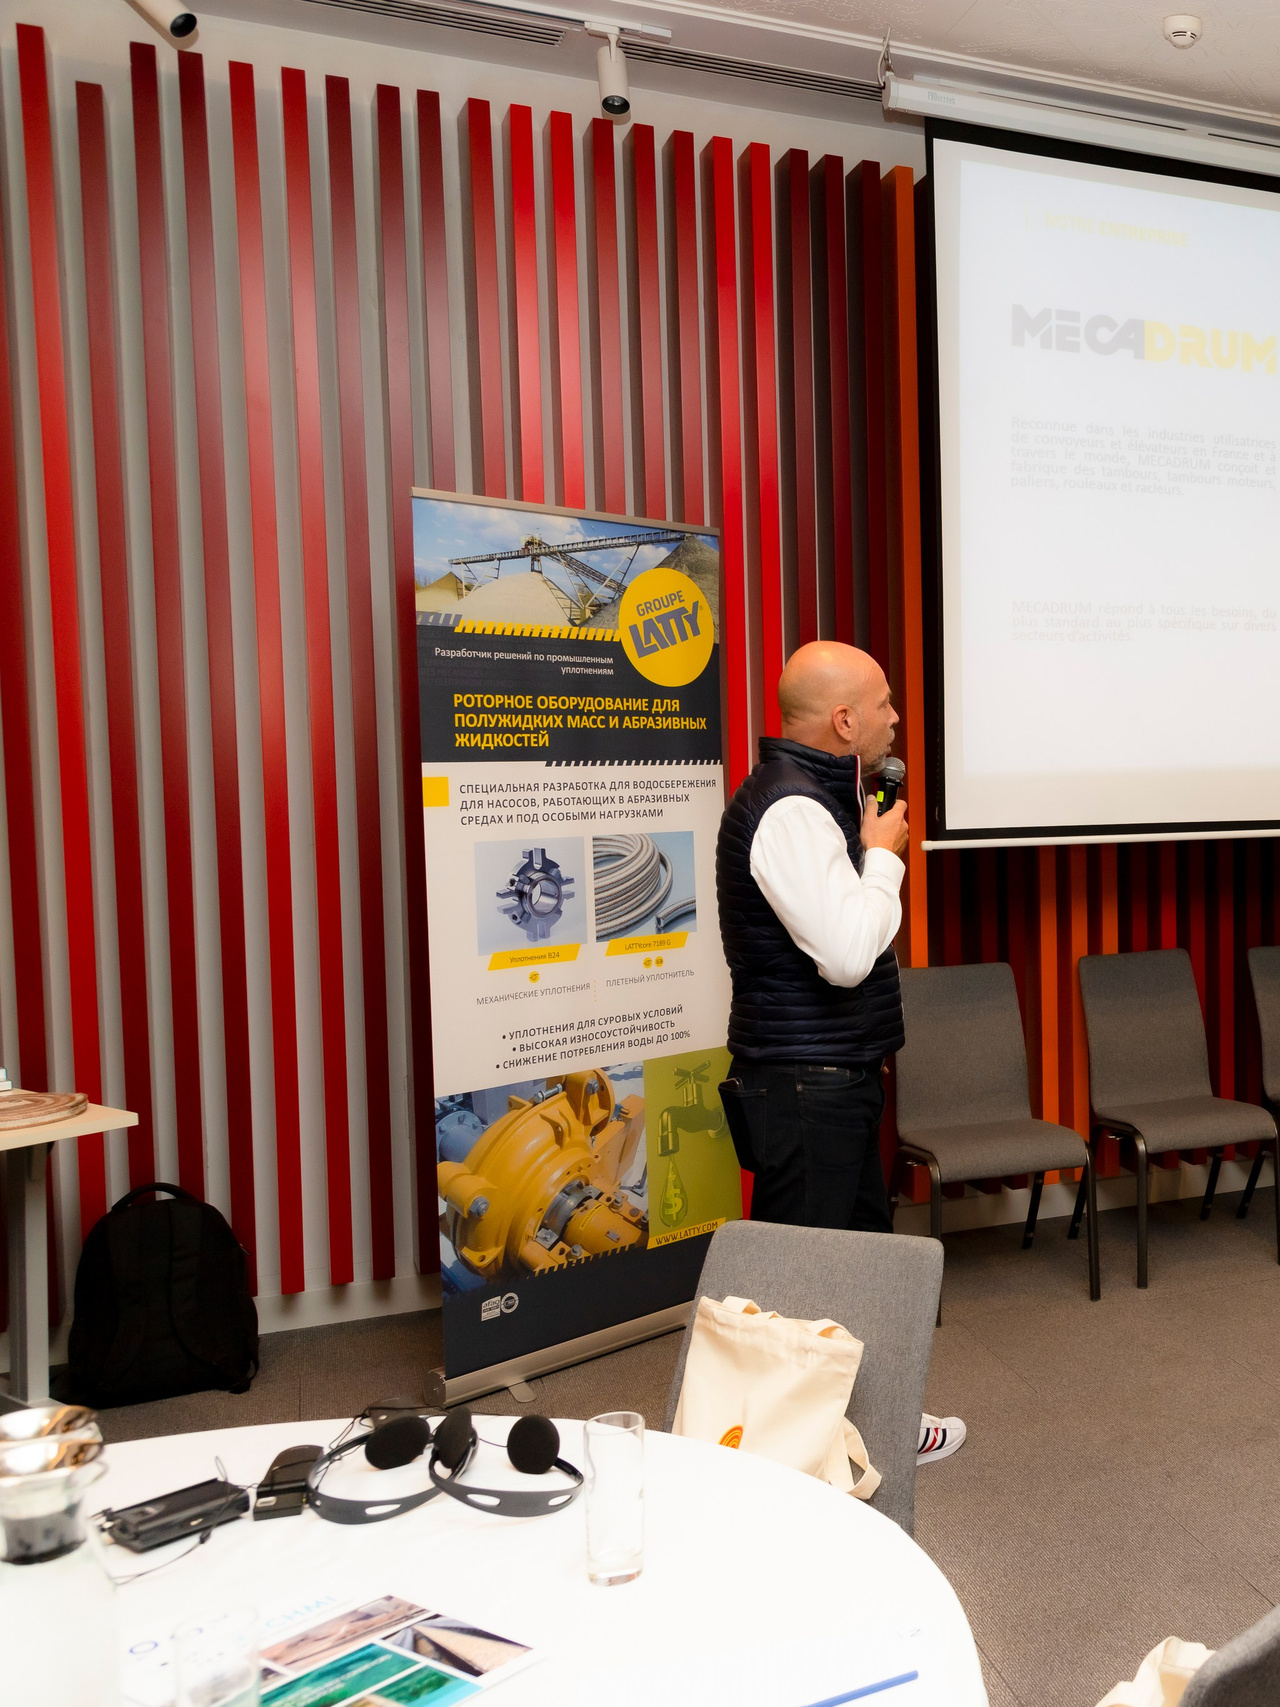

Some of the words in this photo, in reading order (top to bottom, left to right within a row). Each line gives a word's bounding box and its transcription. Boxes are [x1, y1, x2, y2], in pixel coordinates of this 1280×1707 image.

[1044, 212, 1094, 234] NOTRE
[1100, 220, 1188, 248] ENTREPRISE
[1011, 303, 1278, 376] MECADRUM
[1012, 416, 1078, 432] Reconnue
[1086, 421, 1114, 436] dans
[1122, 424, 1140, 438] les
[1148, 426, 1205, 444] industries
[1213, 432, 1276, 450] utilisatrices
[1011, 430, 1028, 444] de
[1034, 435, 1105, 450] convoyeurs
[1110, 439, 1122, 450] et
[1128, 438, 1188, 456] élévateurs
[1192, 446, 1206, 457] en
[1212, 446, 1249, 460] France
[1254, 450, 1265, 462] et
[1270, 450, 1276, 462] à
[1012, 446, 1056, 460] travers
[1065, 447, 1076, 460] le
[1084, 450, 1130, 466] monde,
[1138, 454, 1212, 470] MECADRUM
[1218, 460, 1258, 476] conçoit
[1264, 465, 1276, 476] et
[1011, 460, 1068, 476] fabrique
[1074, 462, 1096, 476] des
[1102, 465, 1162, 482] tambours,
[1167, 470, 1222, 486] tambours
[1228, 476, 1277, 492] moteurs,
[1011, 475, 1059, 490] paliers,
[1064, 478, 1118, 492] rouleaux
[1120, 480, 1132, 492] et
[1136, 480, 1185, 496] racleurs.
[636, 590, 685, 617] GROUPE
[1012, 600, 1092, 614] MECADRUM
[1099, 601, 1144, 618] répond
[1149, 602, 1156, 615] à
[1161, 604, 1186, 616] tous
[1191, 604, 1206, 617] les
[1212, 604, 1257, 620] besoins,
[1262, 606, 1276, 620] du
[628, 600, 700, 659] LATTY
[1012, 615, 1038, 629] plus
[1044, 616, 1100, 628] standard
[1105, 619, 1122, 628] au
[1127, 616, 1152, 630] plus
[1158, 616, 1216, 632] spécifique
[1221, 622, 1238, 631] sur
[1244, 618, 1277, 632] divers
[1012, 630, 1064, 642] secteurs
[434, 647, 492, 661] Разработчик
[494, 650, 532, 663] решений
[534, 653, 544, 662] по
[546, 654, 614, 666] промышленным
[561, 666, 614, 676] уплотнениям
[454, 694, 533, 709] РОТОРНОЕ
[537, 695, 649, 712] ОБОРУДОВАНИЕ
[652, 698, 680, 714] ДЛЯ
[454, 713, 564, 730] ПОЛУЖИДКИХ
[567, 715, 606, 730] МАСС
[609, 716, 619, 730] И
[622, 716, 707, 730] АБРАЗИВНЫХ
[455, 730, 549, 750] ЖИДКОСТЕЙ
[460, 782, 540, 796] СПЕЦИАЛЬНАЯ
[543, 780, 606, 793] РАЗРАБОТКА
[609, 780, 630, 792] ДЛЯ
[632, 778, 716, 791] ВОДОСБЕРЕЖЕНИЯ
[460, 799, 484, 812] ДЛЯ
[487, 797, 540, 810] НАСОСОВ,
[542, 796, 616, 808] РАБОТАЮЩИХ
[618, 794, 624, 804] В
[627, 794, 690, 804] АБРАЗИВНЫХ
[460, 814, 504, 826] СРЕДАХ
[506, 814, 514, 824] И
[516, 812, 540, 825] ПОД
[542, 810, 596, 823] ОСОБЫМИ
[599, 808, 664, 821] НАГРУЗКАМИ
[624, 942, 652, 951] LATTYcore
[652, 940, 666, 948] 7189
[509, 952, 546, 965] Уплотнения
[606, 974, 644, 988] ПЛЕТЕНЫЙ
[646, 969, 695, 984] УПЛОТНИТЕЛЬ
[476, 988, 538, 1006] МЕХАНИЧЕСКИЕ
[540, 982, 591, 998] УПЛОТНЕНИЯ
[508, 1021, 575, 1041] УПЛОТНЕНИЯ
[576, 1018, 596, 1032] ДЛЯ
[598, 1012, 641, 1028] СУРОВЫХ
[642, 1004, 684, 1020] УСЛОВИЙ
[520, 1036, 568, 1053] ВЫСОКАЯ
[570, 1019, 676, 1046] ИЗНОСОУСТОЙЧИВОСТЬ
[502, 1052, 558, 1070] СНИЖЕНИЕ
[560, 1040, 626, 1061] ПОТРЕБЛЕНИЯ
[628, 1035, 654, 1048] ВОДЫ
[656, 1032, 668, 1046] ДО
[670, 1029, 690, 1042] 100%
[656, 1220, 718, 1246] WWW.LATTY.COM
